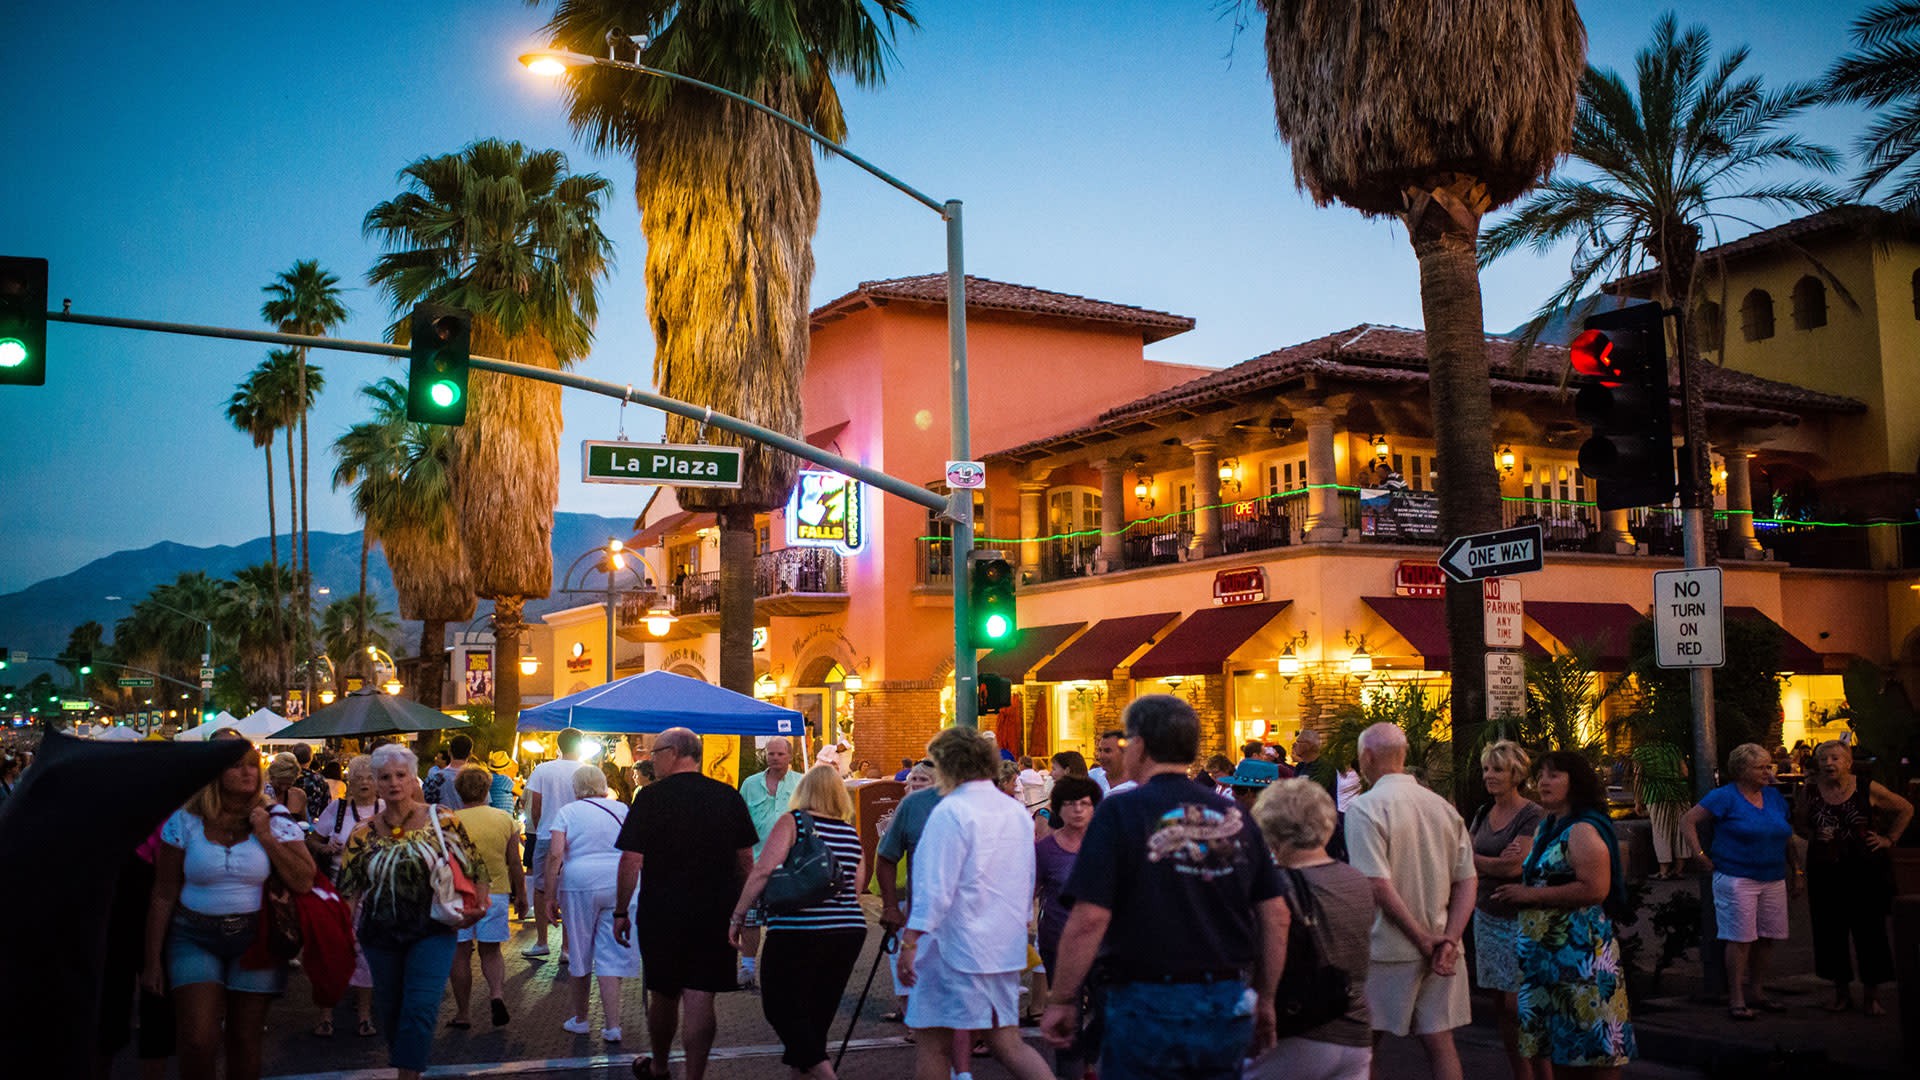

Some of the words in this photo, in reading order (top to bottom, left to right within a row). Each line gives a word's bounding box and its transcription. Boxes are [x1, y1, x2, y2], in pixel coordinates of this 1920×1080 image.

[611, 452, 640, 472] La
[652, 455, 719, 476] Plaza
[1235, 501, 1254, 515] OPE
[798, 525, 844, 539] FALLS
[1468, 547, 1496, 566] ONE
[1501, 542, 1529, 561] WAY
[1485, 581, 1499, 597] NO
[1675, 581, 1700, 598] NO
[1487, 601, 1521, 615] PARKING
[1671, 603, 1706, 617] TURN
[1496, 616, 1512, 627] ANY
[1497, 629, 1512, 640] TIME
[1680, 623, 1698, 637] ON
[1677, 642, 1702, 656] RED
[1499, 657, 1511, 666] NO
[1500, 676, 1512, 684] NO
